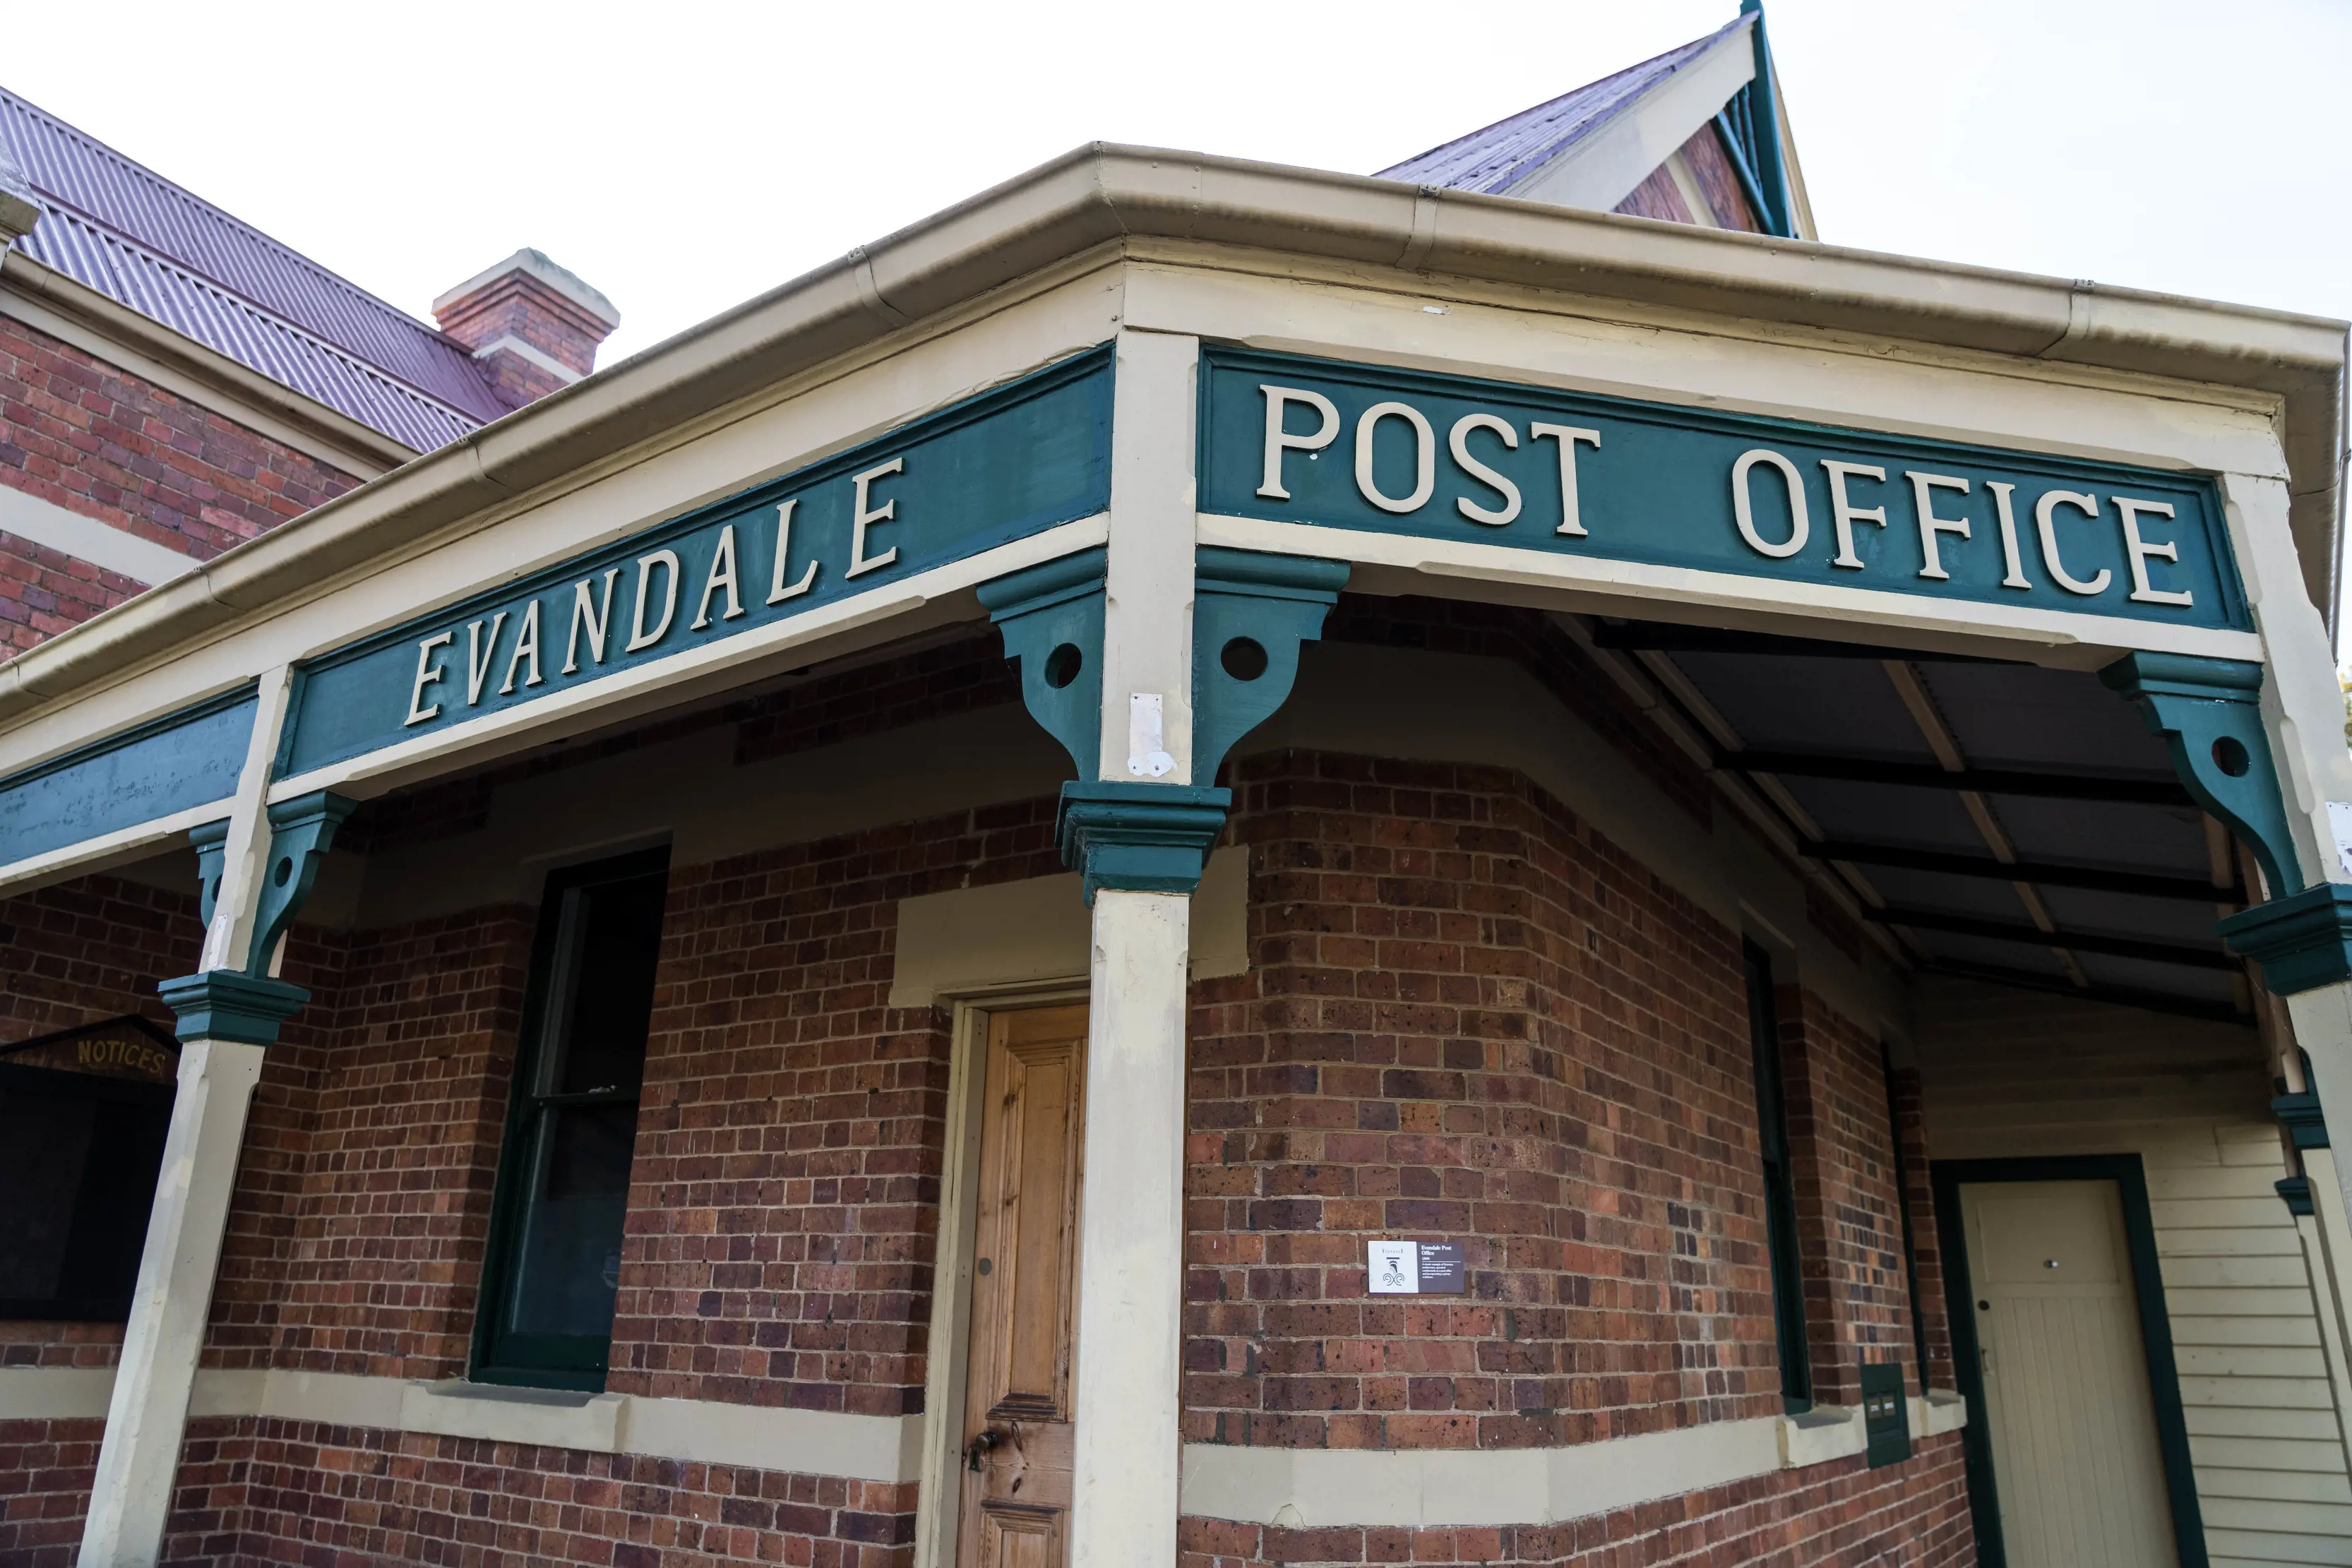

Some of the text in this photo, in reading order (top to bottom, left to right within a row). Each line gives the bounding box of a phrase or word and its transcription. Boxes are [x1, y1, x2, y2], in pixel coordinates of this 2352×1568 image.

[404, 457, 905, 727] EVANDALE
[1256, 383, 2194, 608] POST OFFICE
[77, 1040, 166, 1075] NOTICES
